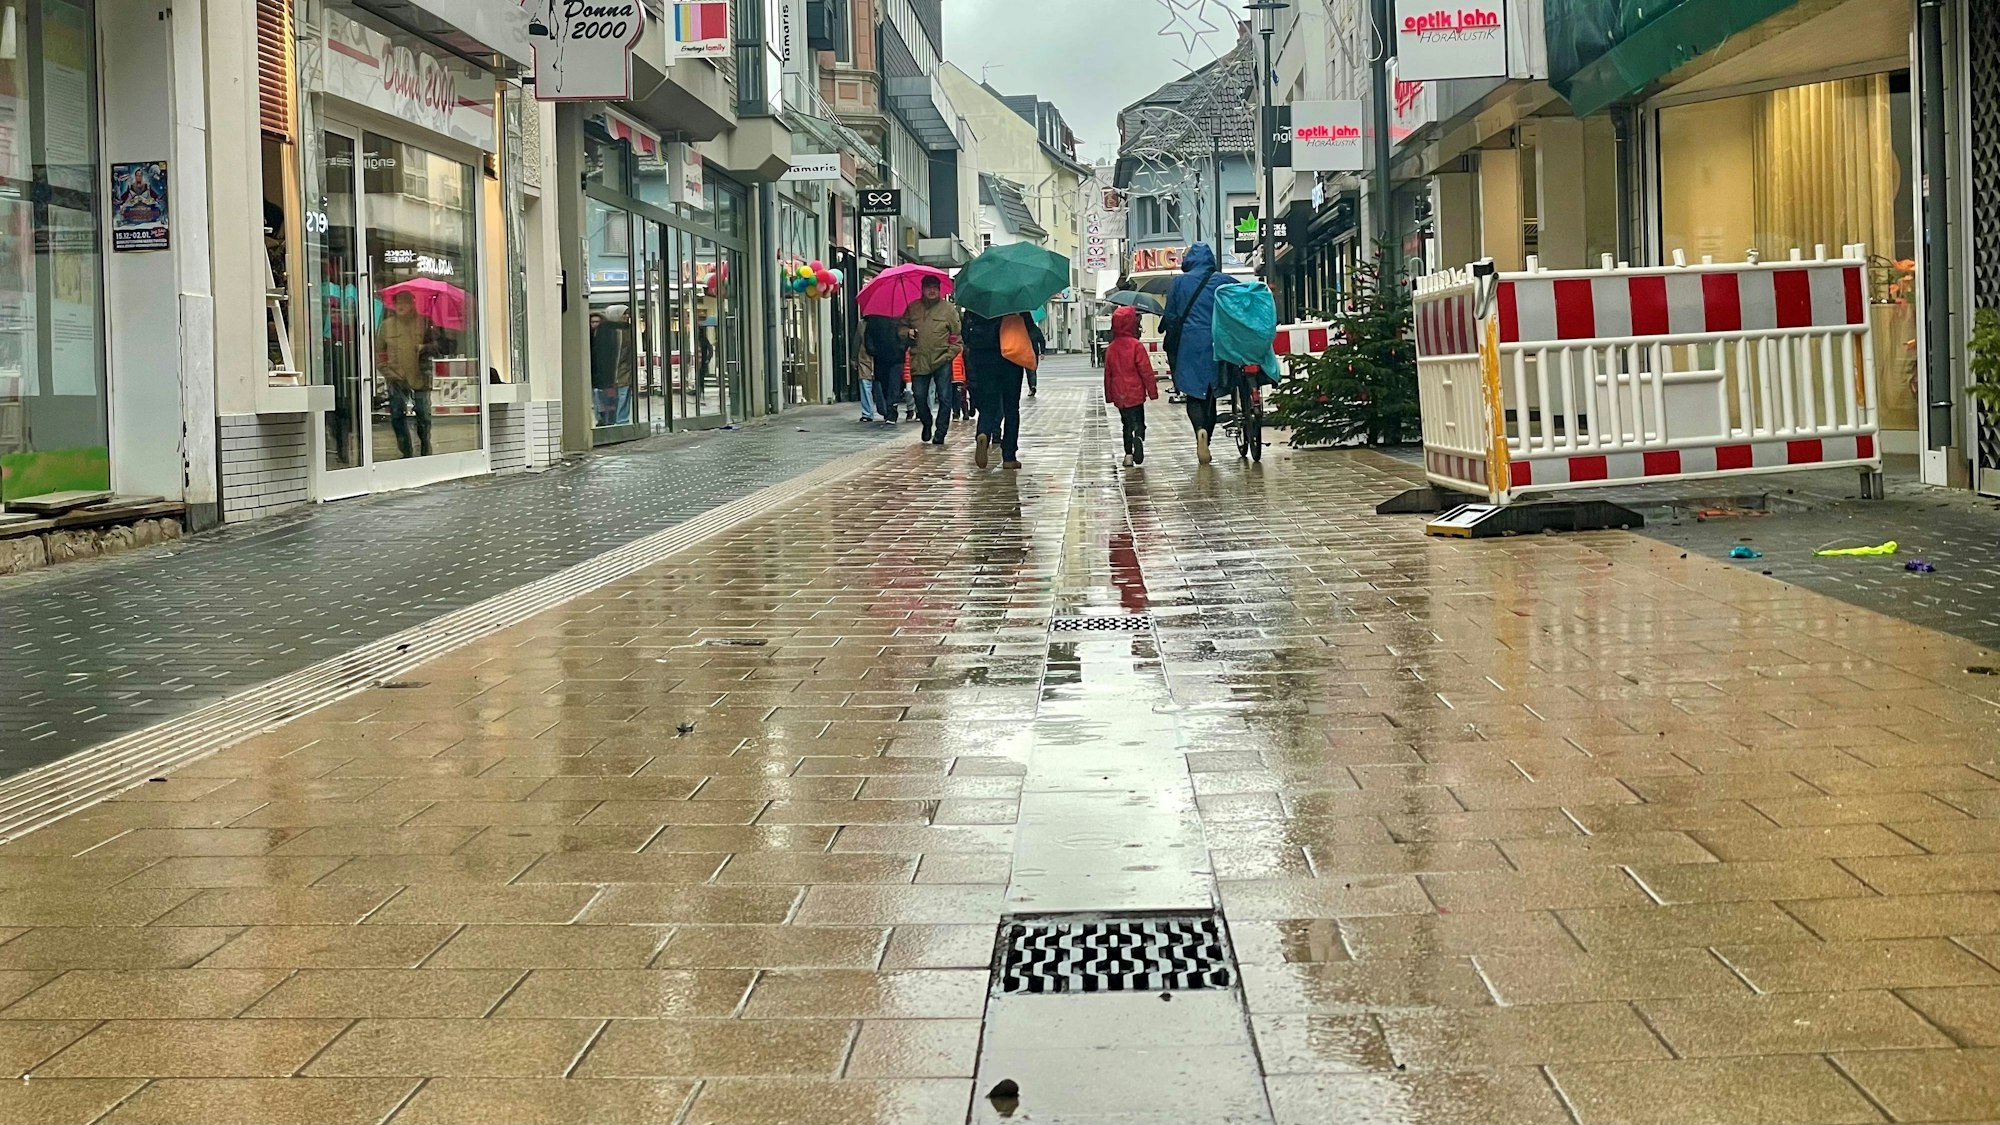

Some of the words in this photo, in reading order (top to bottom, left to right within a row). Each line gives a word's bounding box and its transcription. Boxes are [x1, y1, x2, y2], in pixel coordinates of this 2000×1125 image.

[563, 0, 634, 18] Donna
[571, 21, 627, 39] 2000
[1404, 10, 1451, 36] optik
[1455, 8, 1498, 32] jahn
[782, 4, 790, 68] Tamaris
[705, 43, 726, 51] family
[382, 43, 422, 101] Donna
[424, 65, 456, 116] 2000
[1297, 125, 1329, 141] optik
[1331, 124, 1359, 141] jahn
